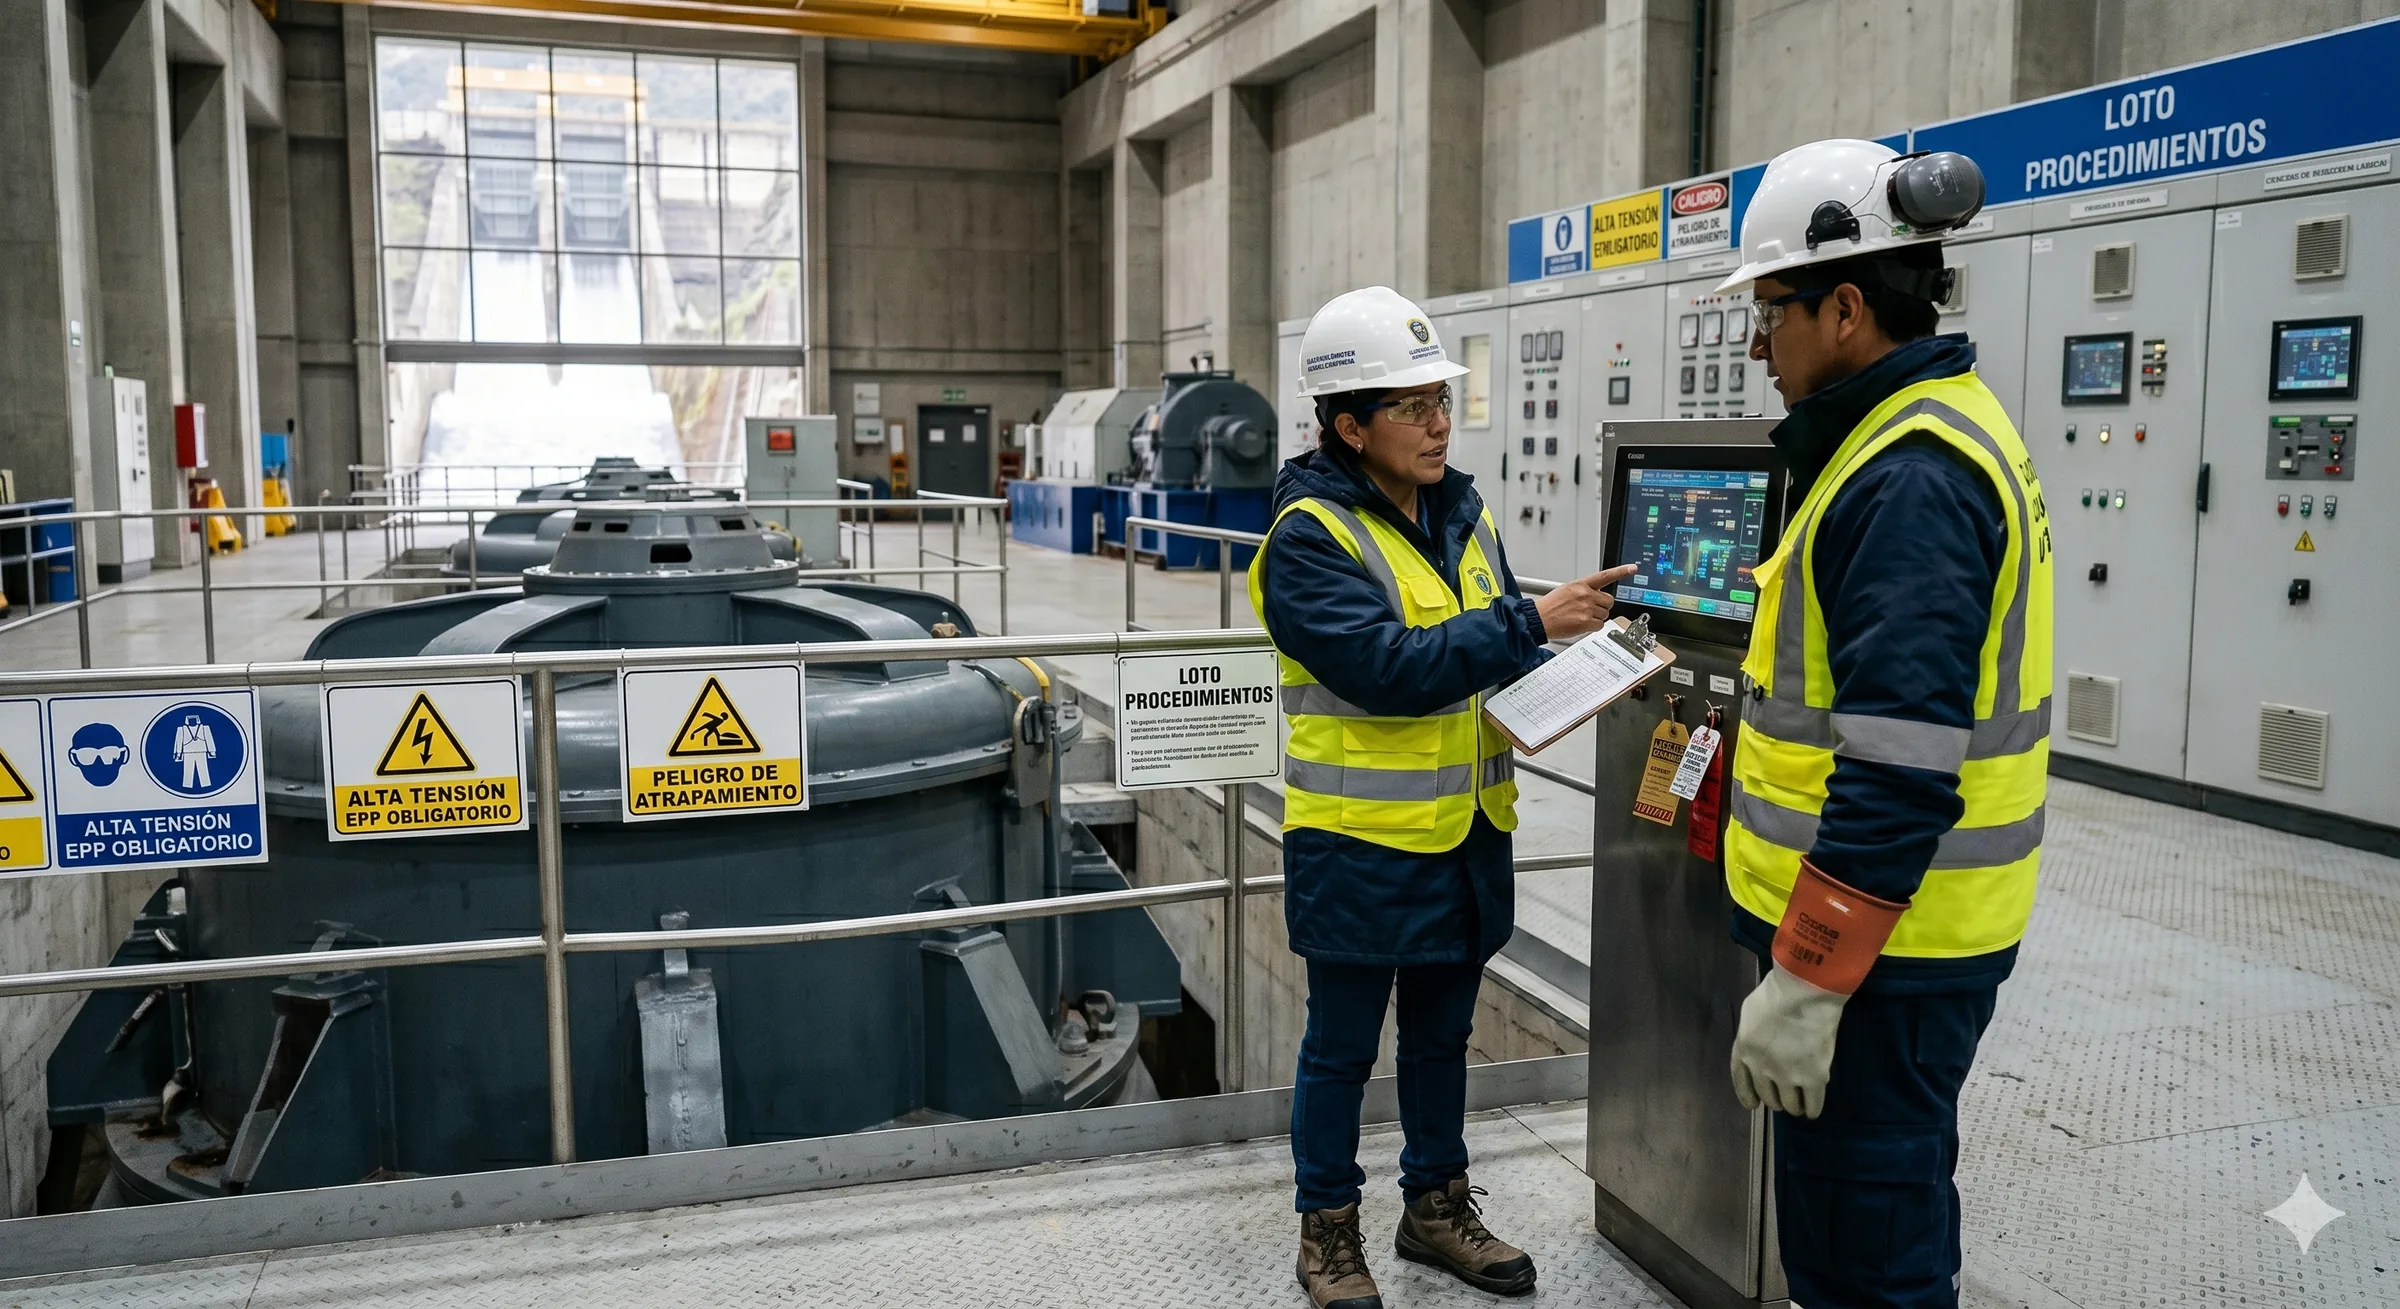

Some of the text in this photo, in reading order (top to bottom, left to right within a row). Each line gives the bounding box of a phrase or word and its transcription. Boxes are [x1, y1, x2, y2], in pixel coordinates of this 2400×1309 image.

[2105, 85, 2175, 131] LOTO
[2025, 118, 2267, 192] PROCEDIMIENTOS
[1594, 203, 1658, 234] ALTA TENSIÓN
[1710, 217, 1720, 229] DE
[1179, 666, 1221, 685] LOTO
[1125, 686, 1273, 710] PROCEDIMIENTOS
[653, 765, 778, 787] PELIGRO DE
[347, 780, 505, 807] ALTA TENSIÓN
[635, 784, 797, 809] ATRAPAMIENTO
[84, 810, 231, 837] ALTA TENSIÓN
[346, 804, 511, 827] EPP OBLIGATORIO
[66, 833, 253, 859] EPP OBLIGATORIO
